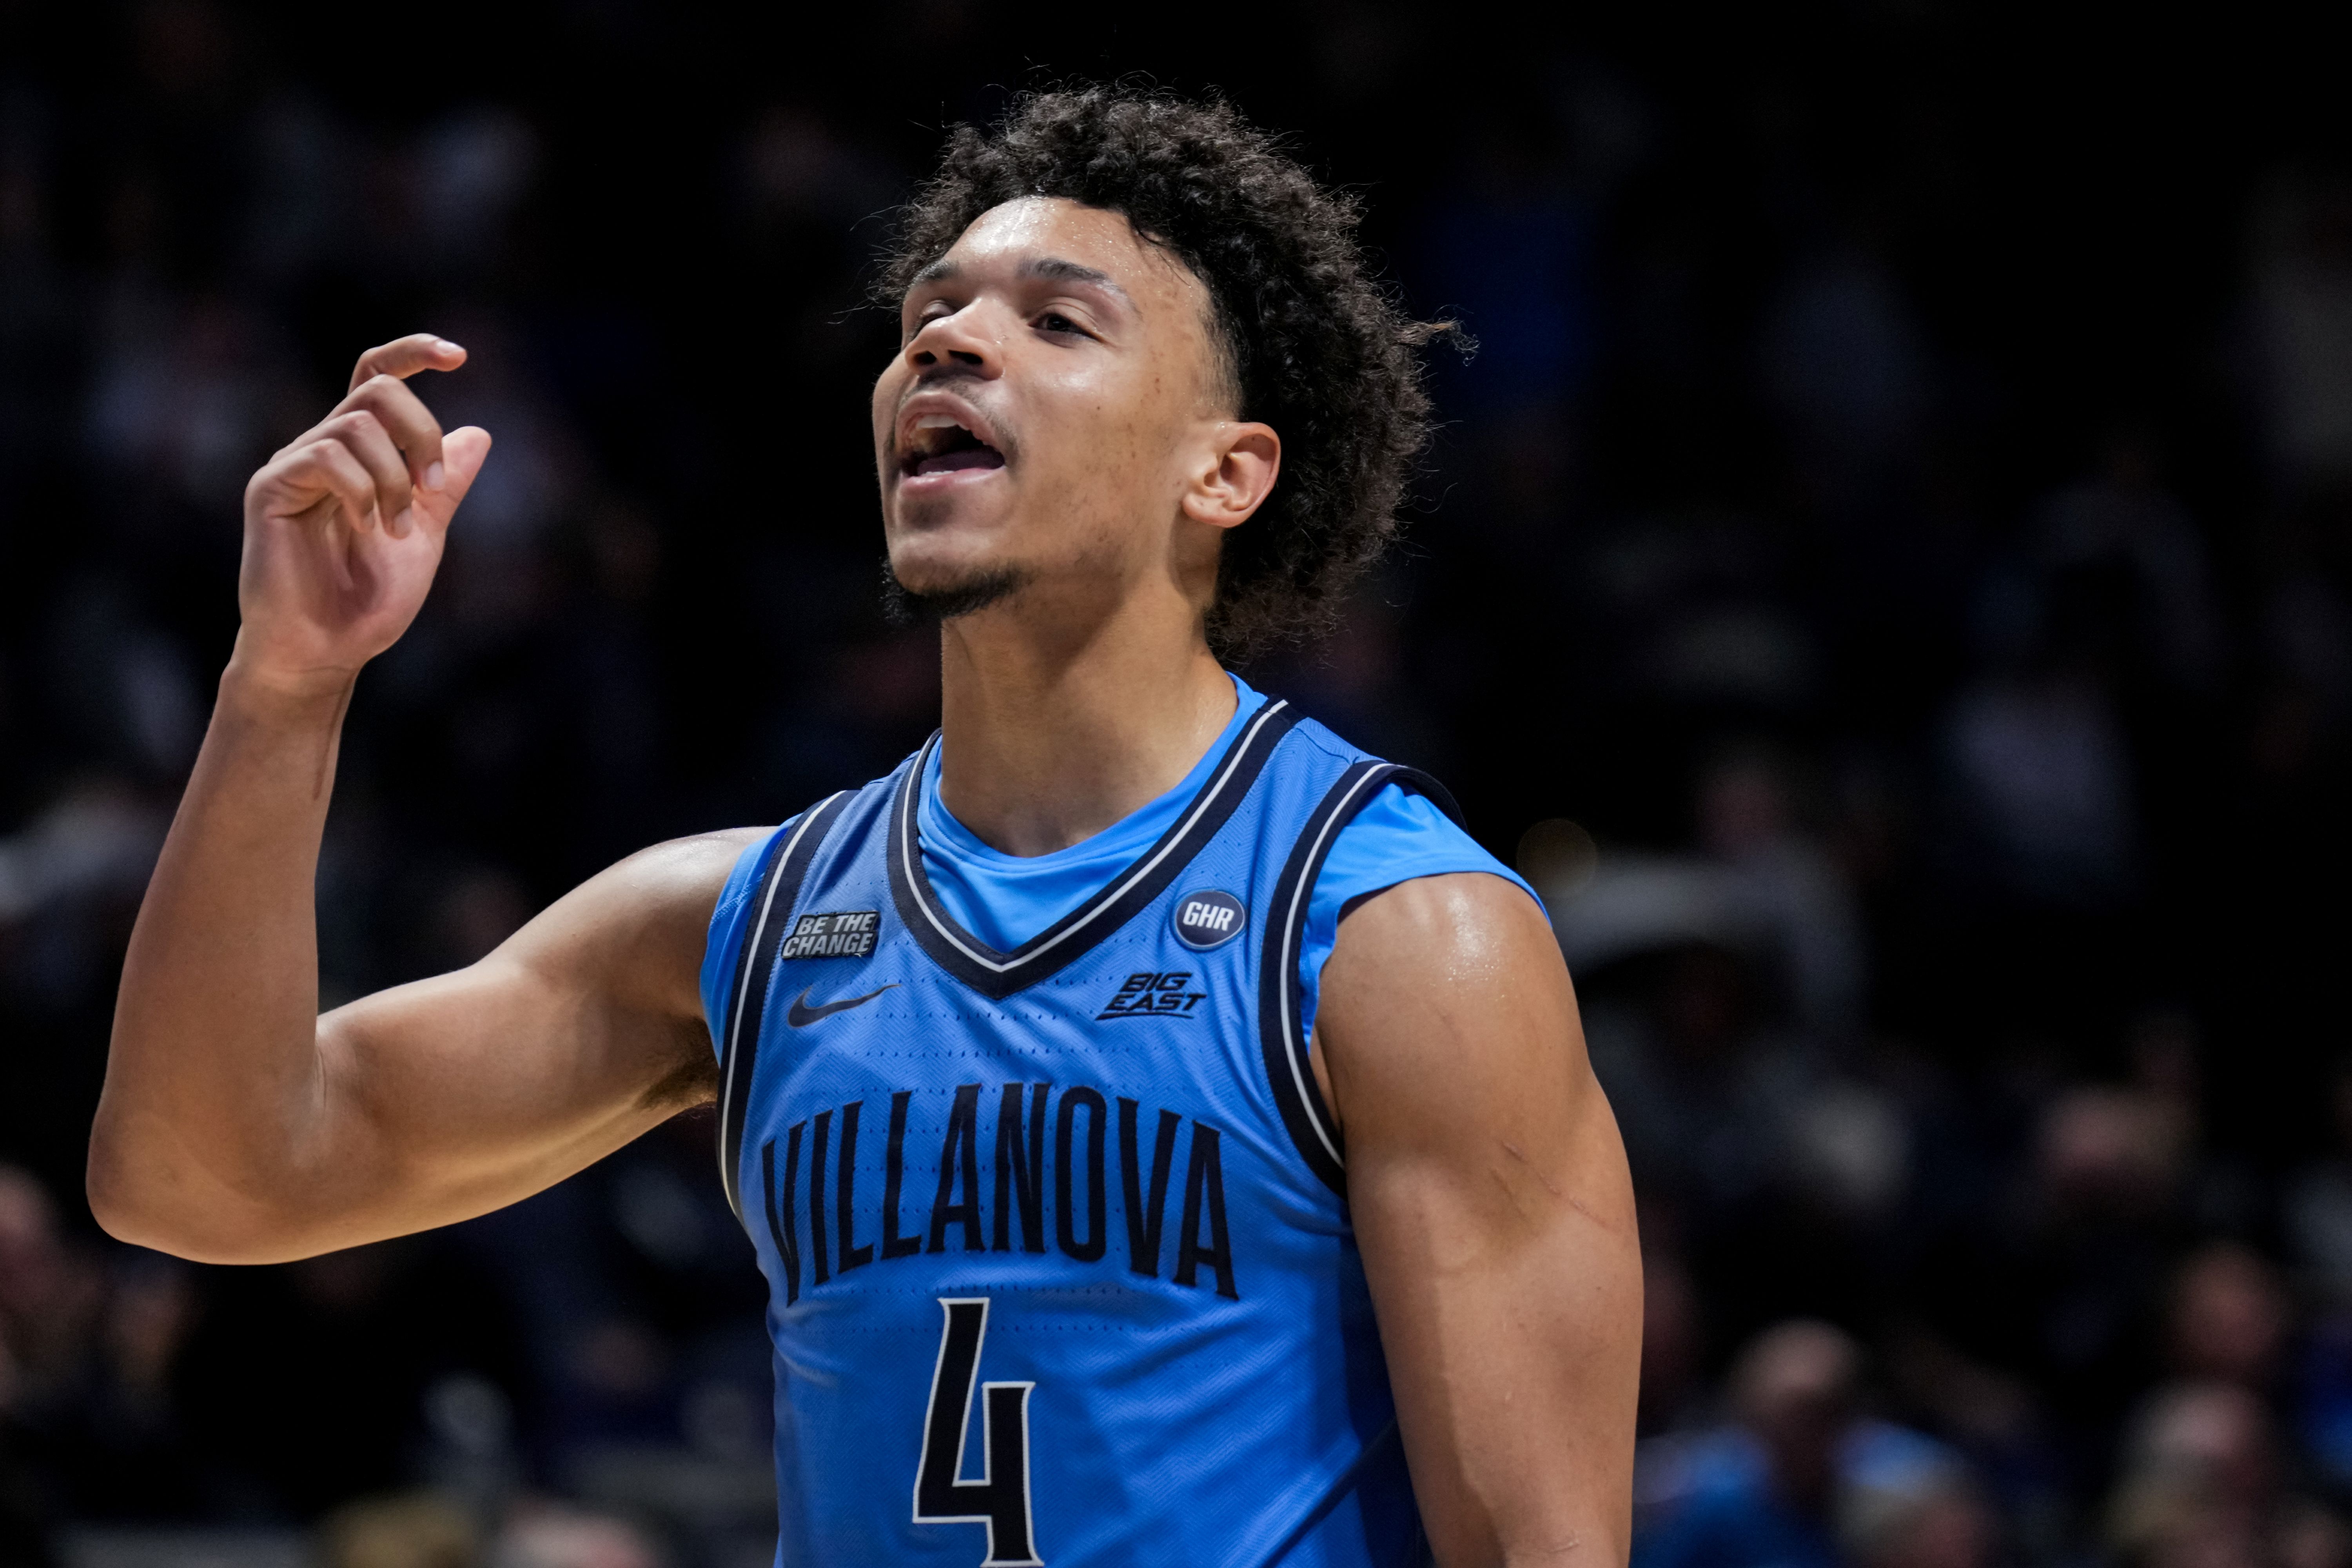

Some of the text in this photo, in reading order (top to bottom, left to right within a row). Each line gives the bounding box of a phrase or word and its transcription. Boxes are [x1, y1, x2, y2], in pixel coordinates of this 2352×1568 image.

[797, 913, 876, 935] BE THE
[1183, 901, 1235, 931] GHR
[783, 933, 873, 956] CHANGE
[1119, 972, 1192, 992] BIG
[1104, 993, 1207, 1011] EAST
[762, 1082, 1240, 1308] VILLANOVA
[912, 1297, 1045, 1568] 4
